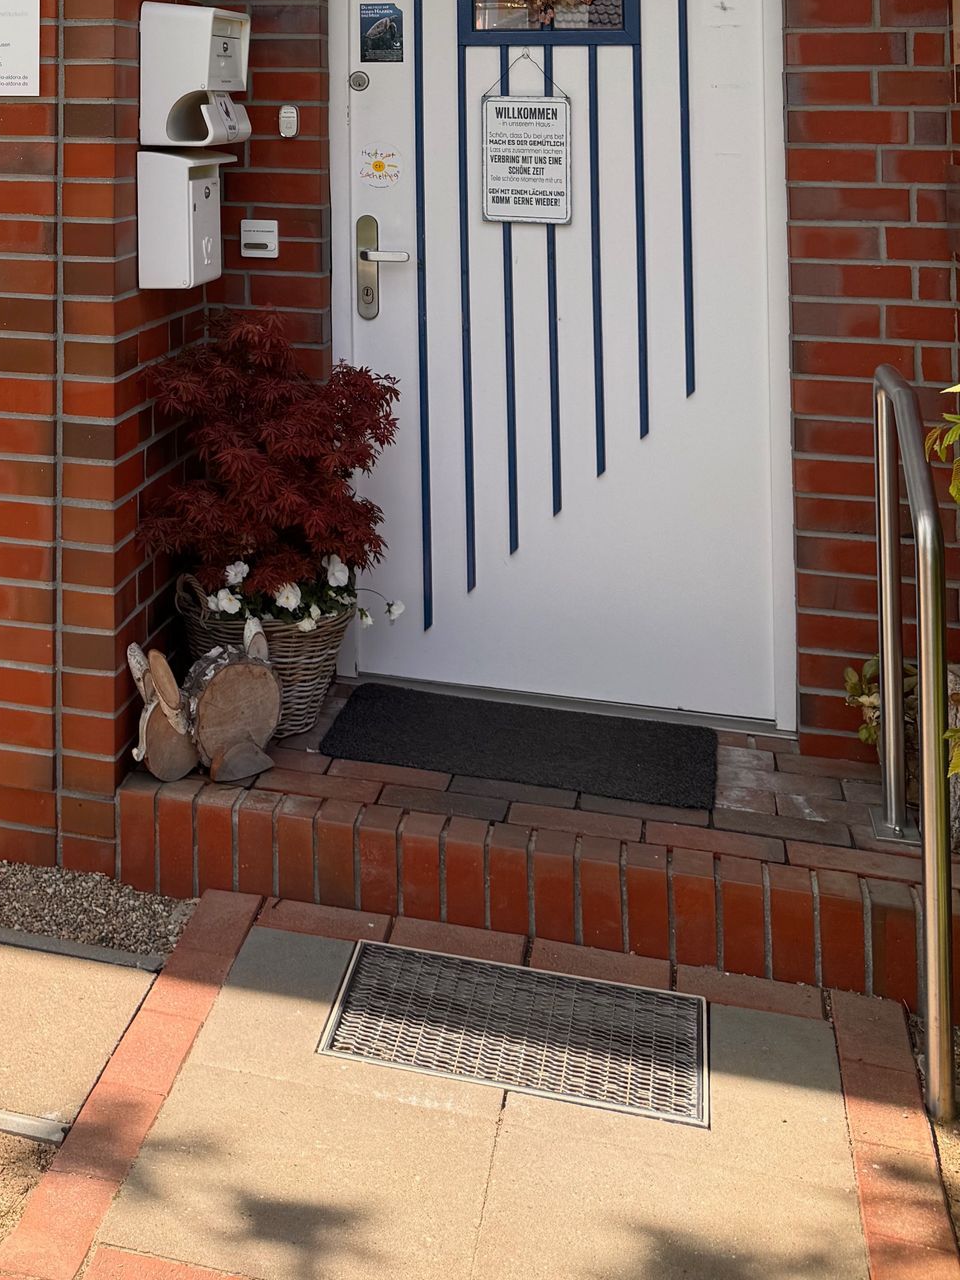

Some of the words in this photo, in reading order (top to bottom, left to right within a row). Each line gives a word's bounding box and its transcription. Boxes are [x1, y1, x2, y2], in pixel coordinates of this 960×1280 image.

[494, 106, 558, 120] WILLKOMMEN
[528, 139, 564, 147] GEMÜTLICH
[521, 155, 533, 164] MIT
[534, 156, 547, 165] UNS
[548, 156, 562, 166] EINE
[508, 165, 531, 176] SCHÖNE
[532, 166, 544, 176] ZEIT
[513, 196, 534, 206] GERNE
